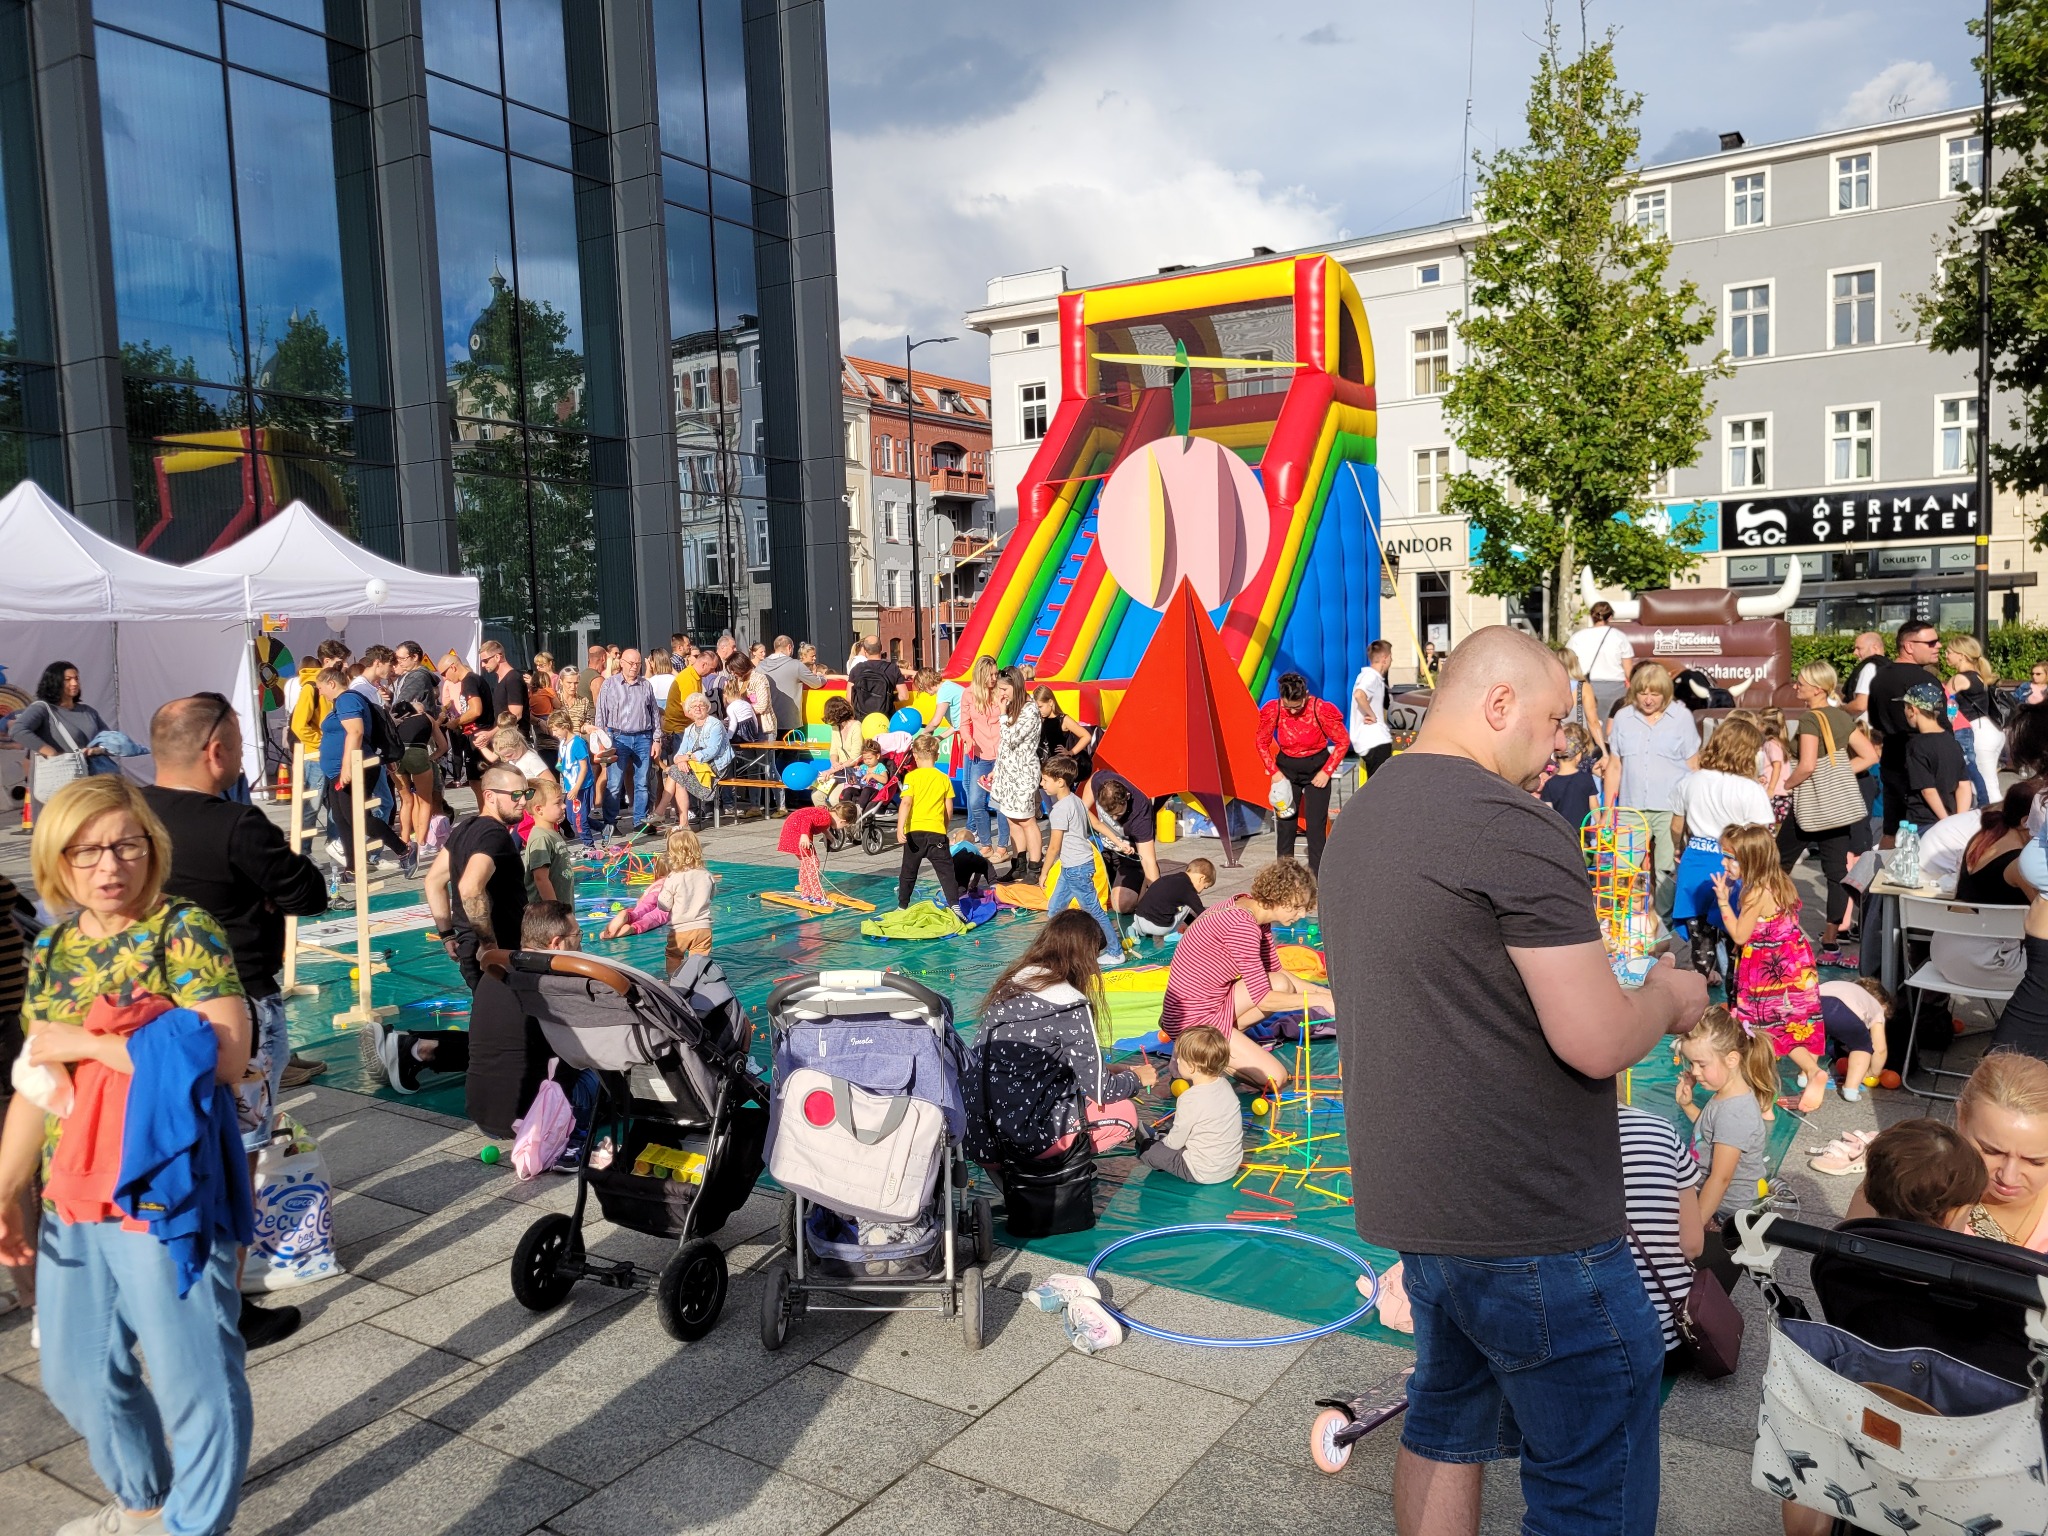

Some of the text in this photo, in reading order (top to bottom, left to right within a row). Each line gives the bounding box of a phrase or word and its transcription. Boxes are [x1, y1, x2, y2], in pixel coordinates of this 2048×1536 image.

[1813, 493, 1968, 519] GERMAN
[1813, 511, 1977, 542] OPTIKER
[1380, 537, 1452, 554] ANDOR
[1784, 561, 1813, 569] OYK
[1882, 556, 1927, 565] OKULISTA
[1679, 634, 1721, 645] OGÓRKA
[298, 1231, 315, 1250] bag
